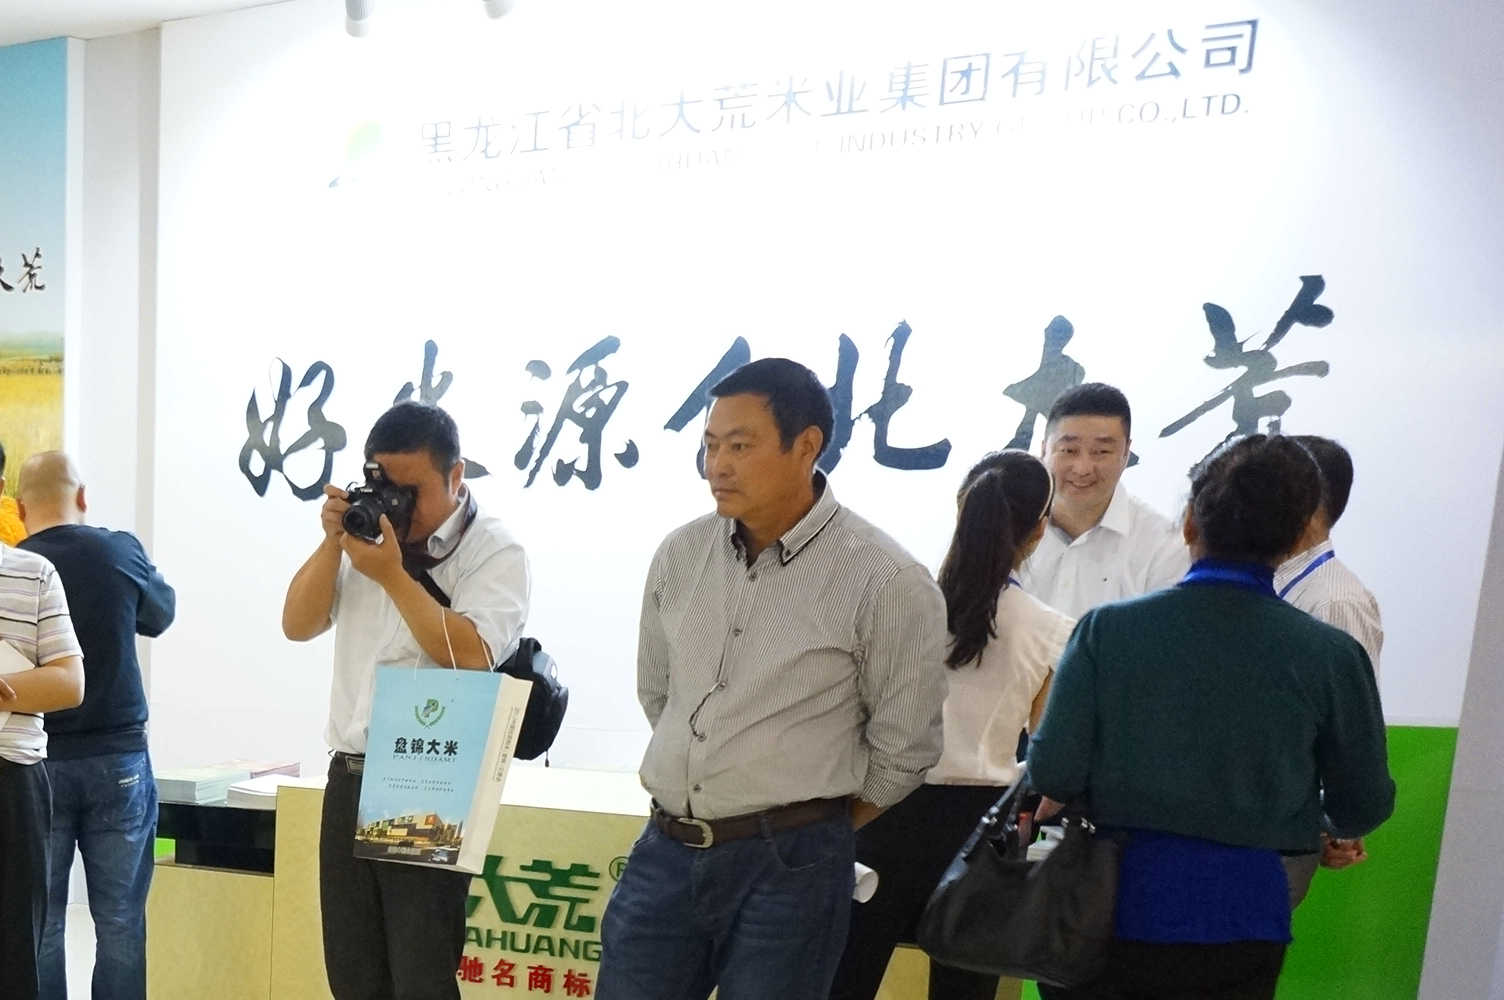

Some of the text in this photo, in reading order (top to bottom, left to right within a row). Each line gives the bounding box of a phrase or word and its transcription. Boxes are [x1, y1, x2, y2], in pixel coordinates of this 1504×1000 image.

[421, 18, 1259, 163] 黑龙江省北大荒米业集团有限公司
[393, 736, 458, 756] 盘锦大米
